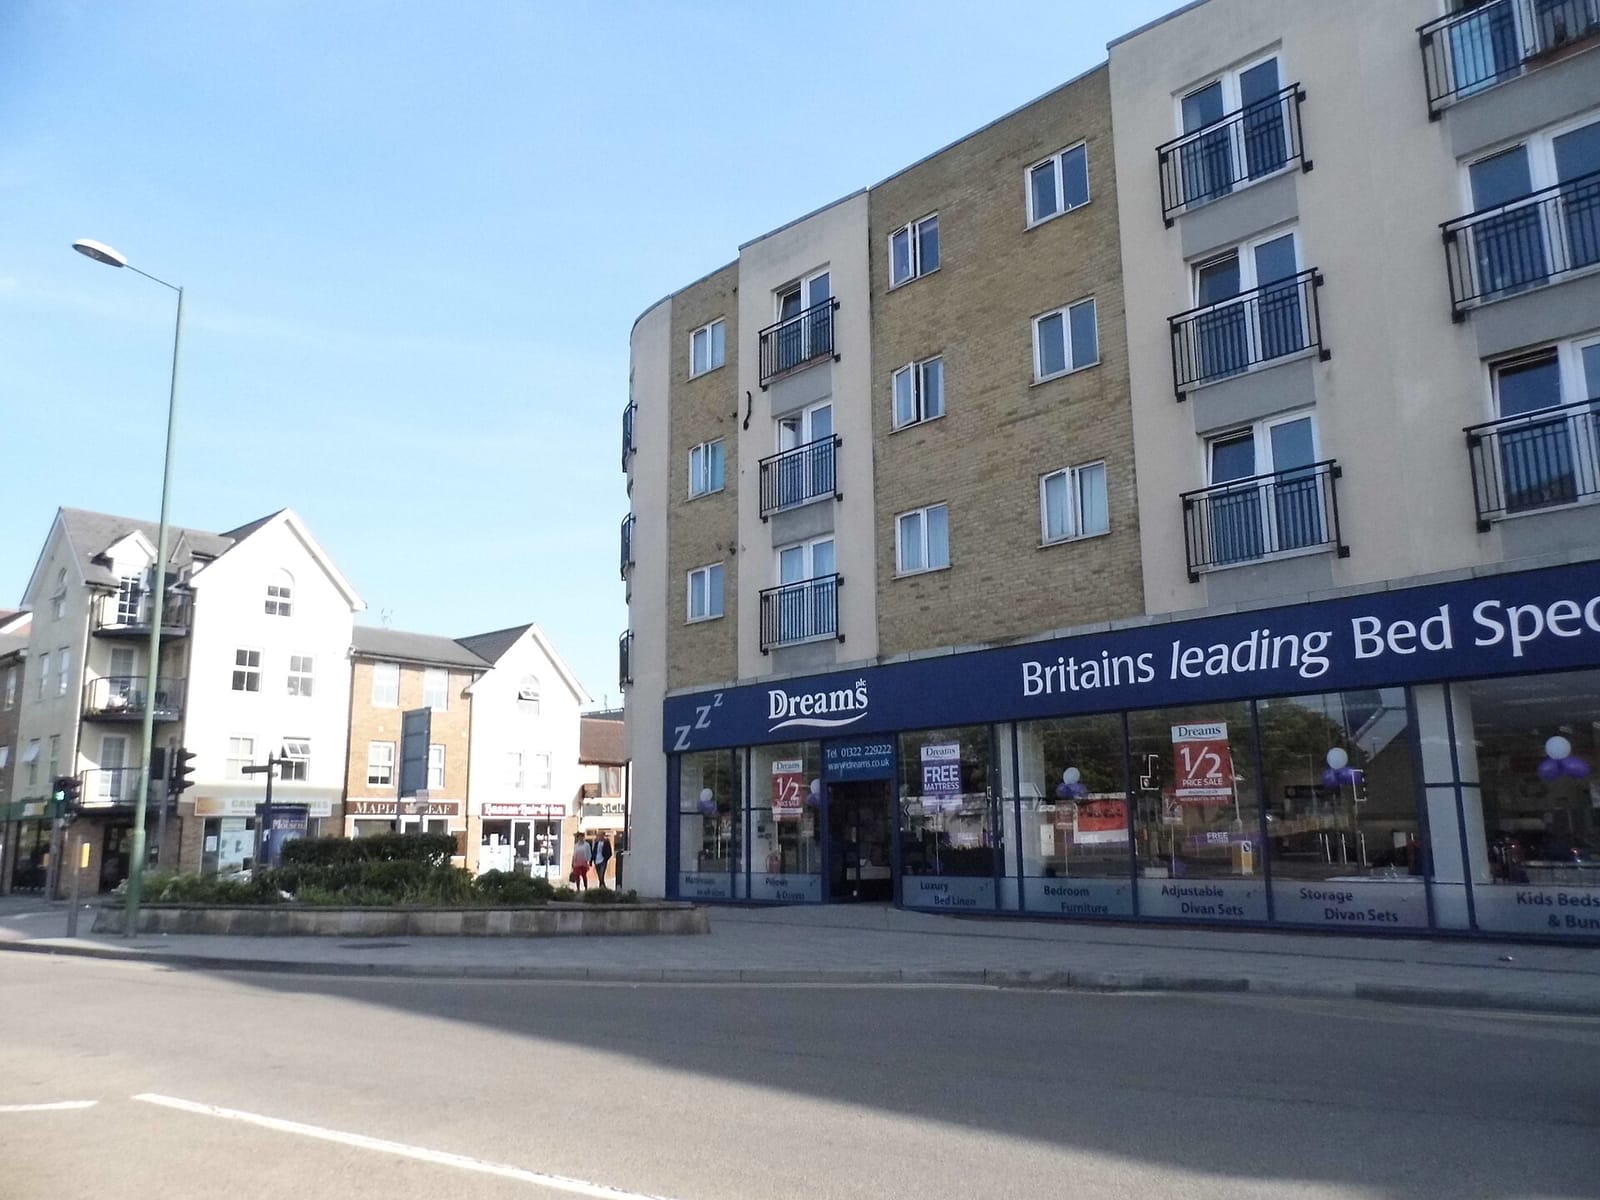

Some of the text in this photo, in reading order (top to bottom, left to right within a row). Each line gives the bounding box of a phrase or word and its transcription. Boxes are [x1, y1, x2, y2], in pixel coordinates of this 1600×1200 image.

[1022, 650, 1155, 697] Britains
[1170, 628, 1333, 679] leading
[1351, 603, 1453, 660] Bed
[767, 687, 869, 720] Dreams
[1178, 726, 1222, 737] Dreams
[841, 746, 862, 757] 01322
[864, 744, 892, 756] 229222
[926, 747, 956, 756] Dreams
[1180, 746, 1223, 779] 1/2
[923, 765, 960, 783] FREE
[776, 777, 800, 801] 1/2
[923, 782, 960, 791] MATTRESS
[1182, 778, 1223, 787] PRICE SALE
[920, 881, 948, 893] Luxury
[1043, 885, 1090, 897] Bedroom
[1161, 884, 1224, 898] Adjustable
[934, 895, 976, 906] Bed Linen
[1300, 887, 1353, 904] Storage
[1516, 891, 1553, 906] Kids
[1060, 901, 1108, 914] Furniture
[1181, 902, 1244, 916] Divan Sets
[1324, 908, 1398, 922] Divan Sets
[1548, 913, 1560, 927] &
